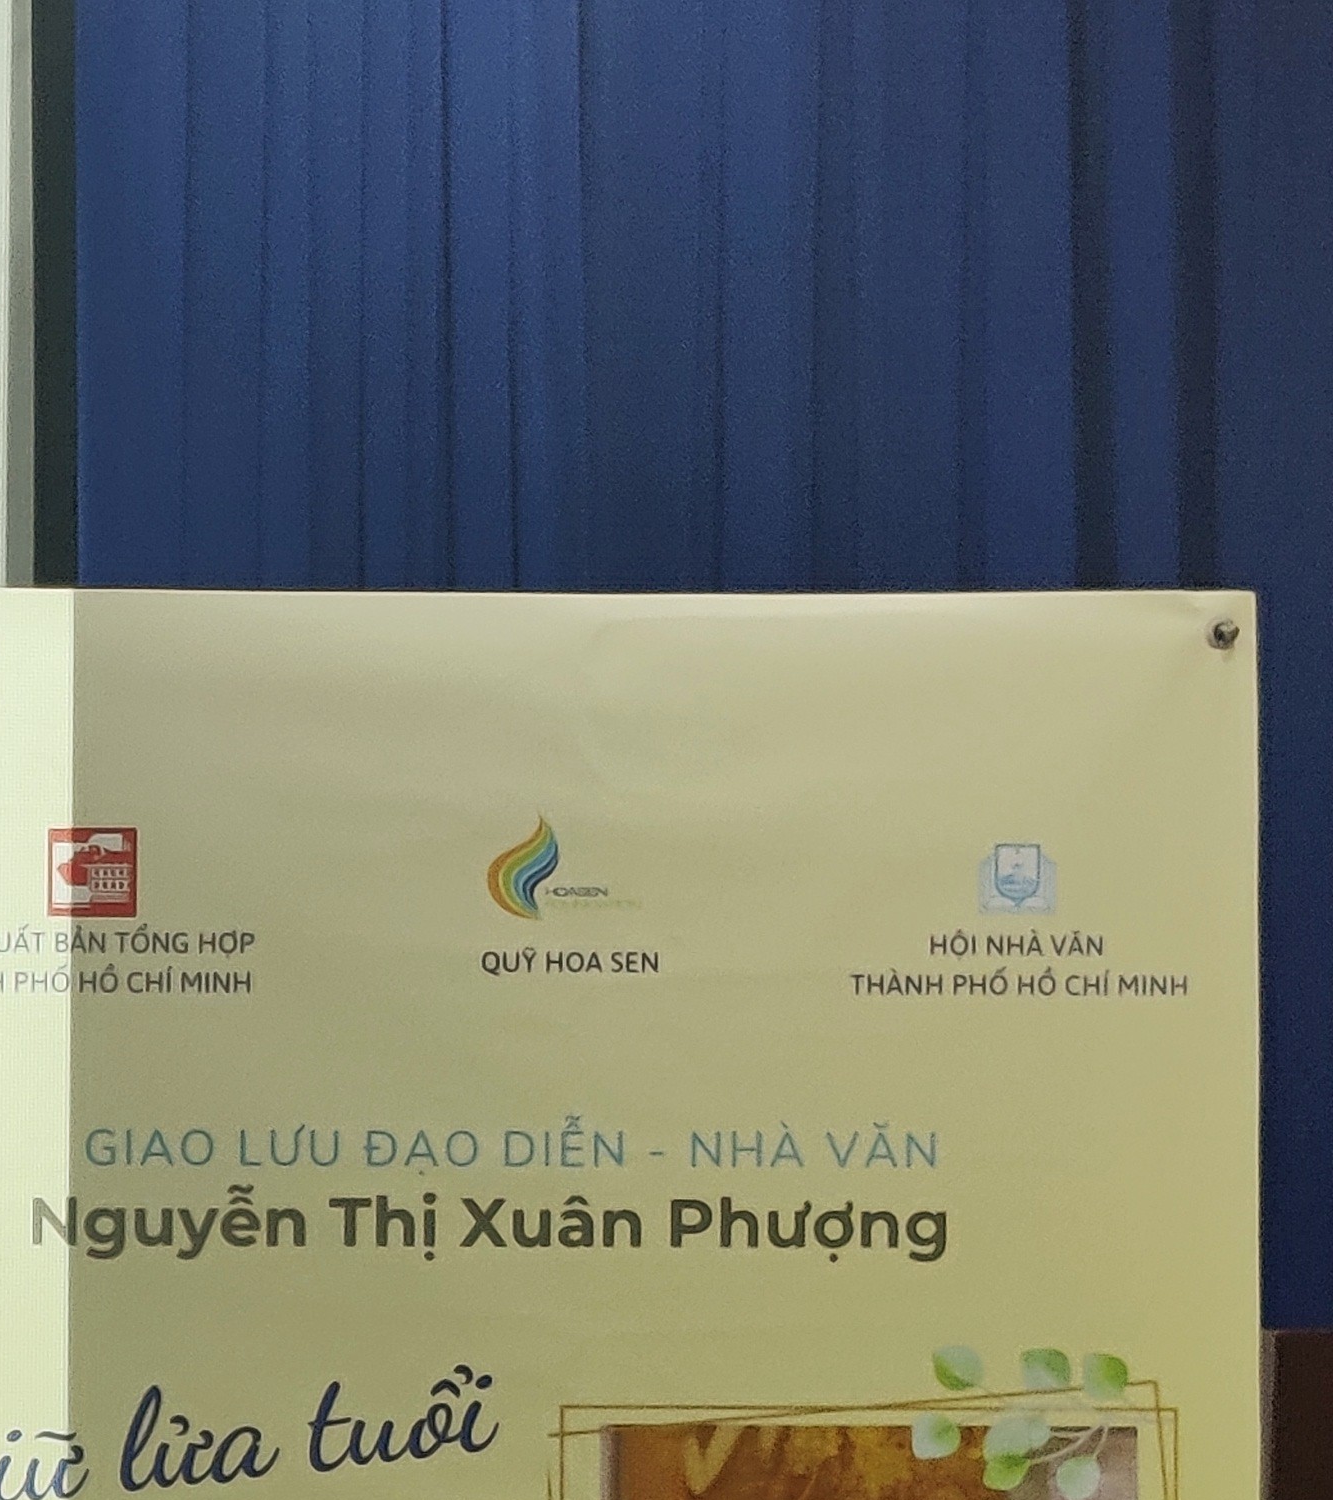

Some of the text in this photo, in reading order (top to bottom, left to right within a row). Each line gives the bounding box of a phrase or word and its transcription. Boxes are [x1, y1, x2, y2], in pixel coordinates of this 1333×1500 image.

[54, 925, 107, 955] BẢN
[114, 923, 189, 955] TỔNG
[197, 930, 256, 958] HỢP
[929, 929, 1104, 959] HỘI NHÀ VĂN
[481, 947, 660, 976] QUỸ HOA SEN
[13, 963, 71, 995] PHỐ
[78, 963, 119, 995] HỒ
[126, 964, 173, 995] CHÍ
[180, 971, 253, 995] MINH
[850, 969, 1189, 998] THÀNH PHỐ HỒ CHÍ MINH
[85, 1127, 215, 1168] GIAO
[239, 1123, 339, 1168] LƯU
[363, 1127, 479, 1176] ĐẠO
[504, 1115, 625, 1168] DIỄN
[690, 1120, 805, 1169] NHÀ
[825, 1120, 937, 1169] VĂN
[32, 1183, 948, 1263] Nguyễn Thị Xuân Phượng
[119, 1384, 279, 1491] lửa
[308, 1364, 499, 1471] tuổi
